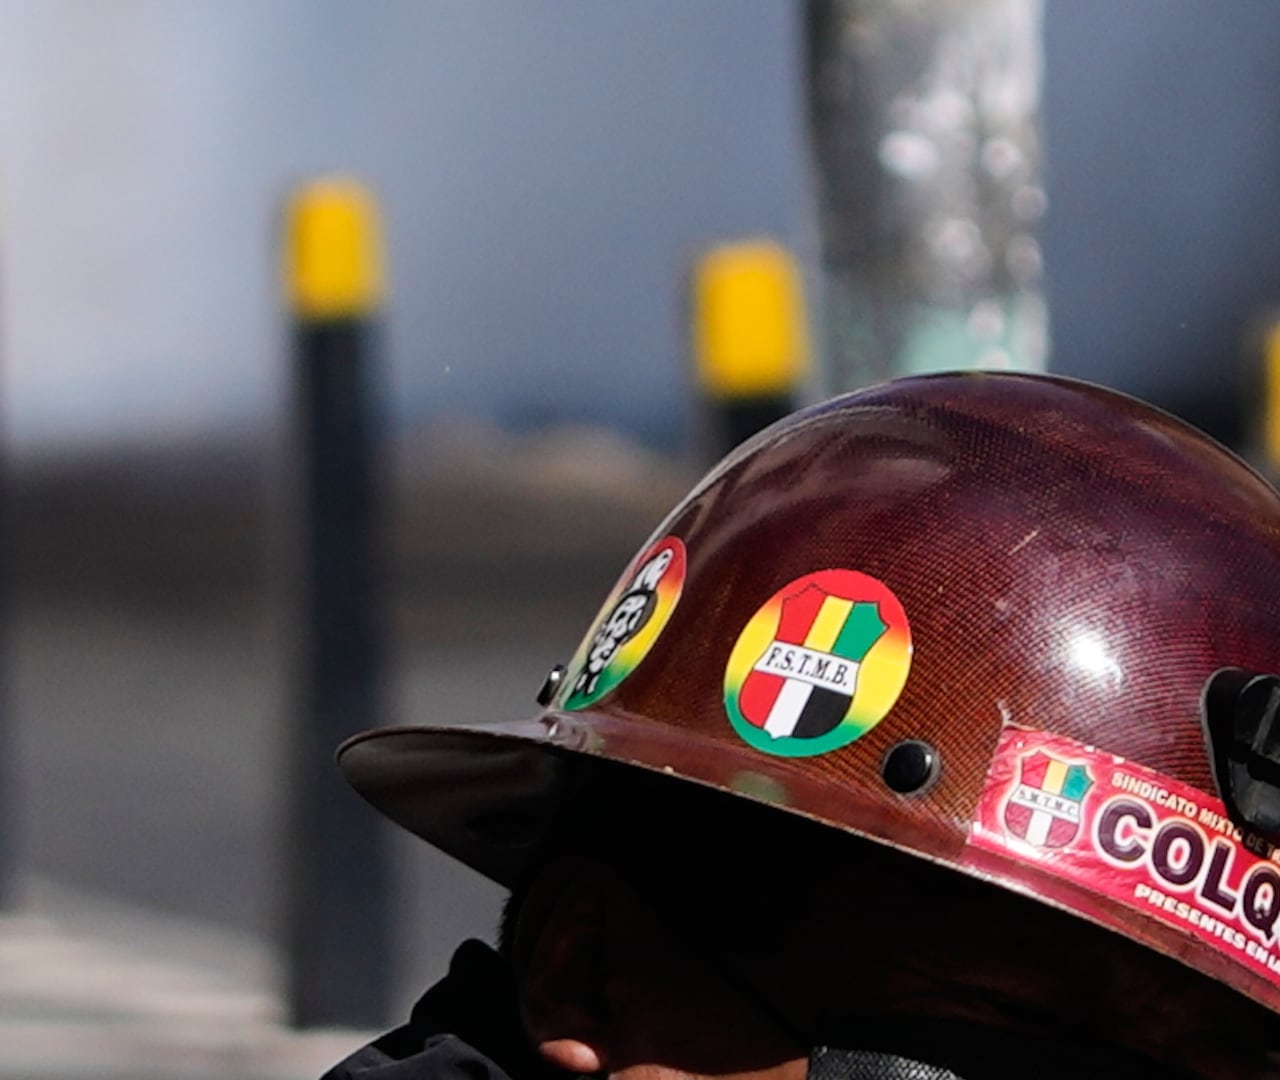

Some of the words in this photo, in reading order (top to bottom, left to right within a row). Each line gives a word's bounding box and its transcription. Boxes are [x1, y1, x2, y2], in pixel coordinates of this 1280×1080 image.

[765, 647, 848, 687] F.S.T.M.B.
[1111, 771, 1198, 818] SINDICATO
[1198, 807, 1245, 842] MIXTO
[1245, 833, 1265, 854] DE
[1134, 883, 1246, 950] PRESENTES
[1245, 940, 1269, 964] EN
